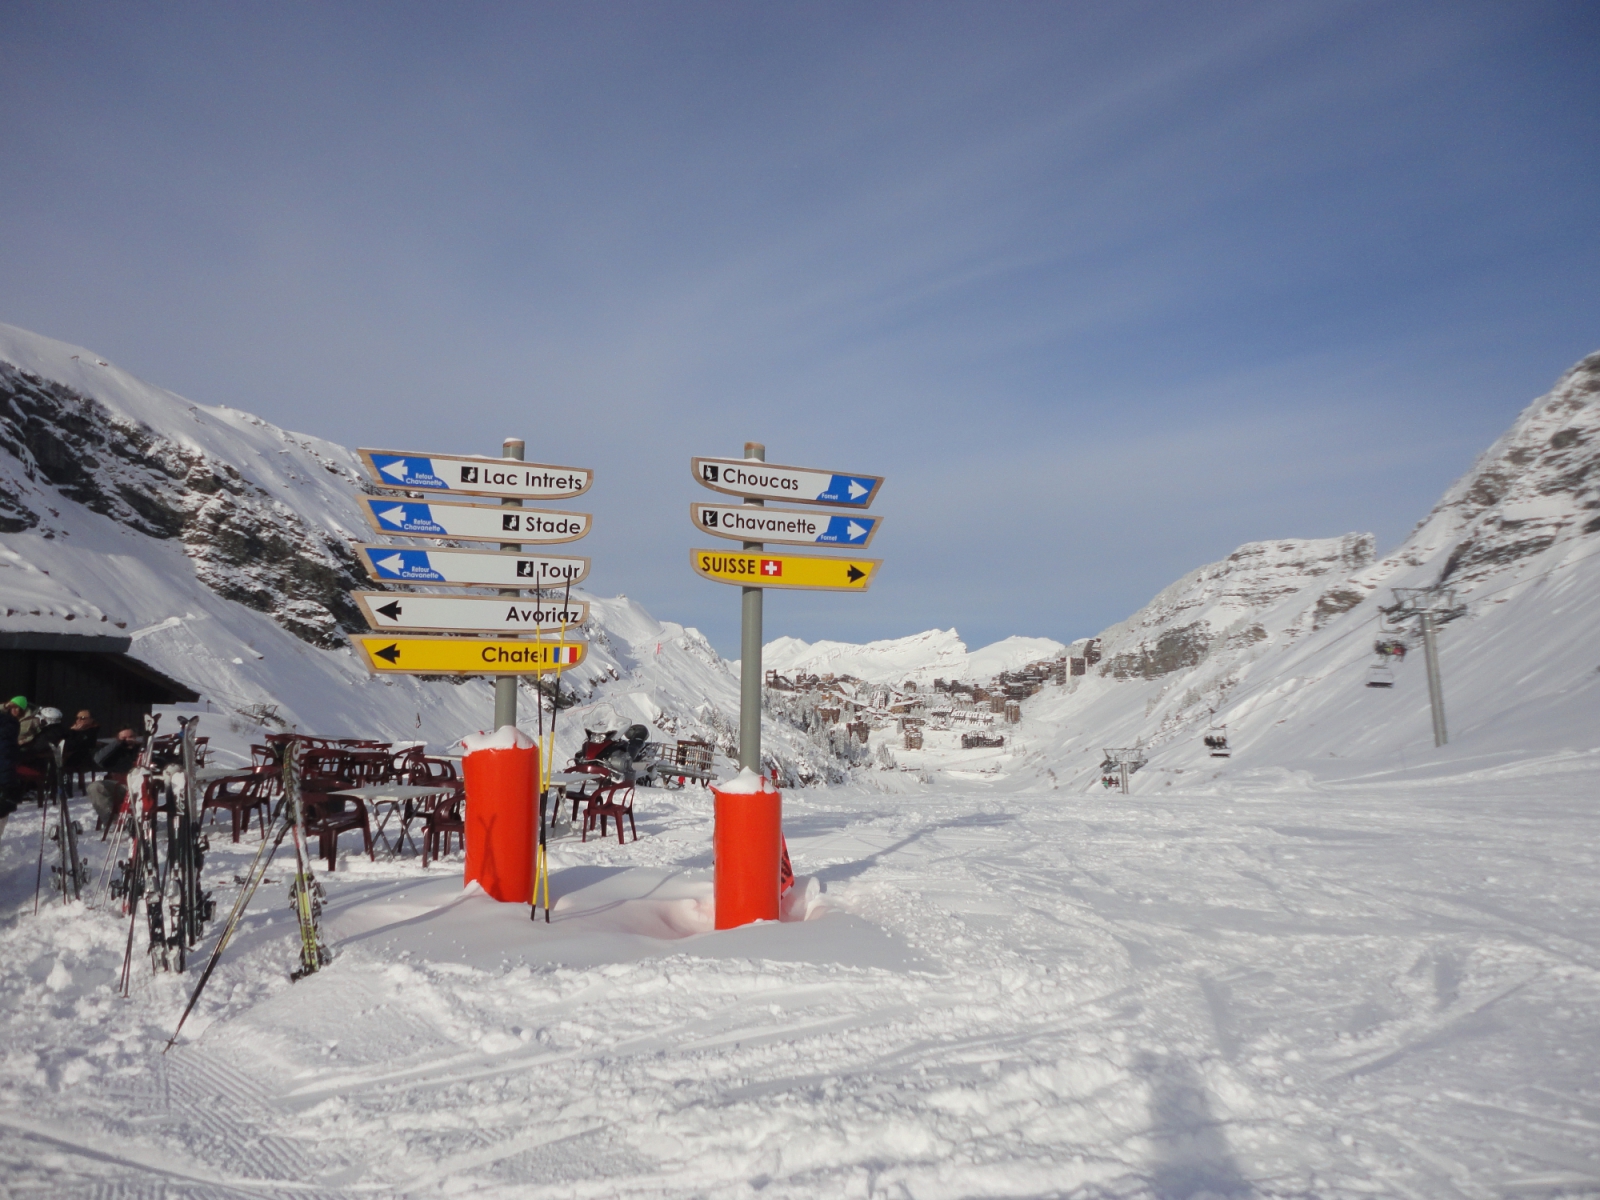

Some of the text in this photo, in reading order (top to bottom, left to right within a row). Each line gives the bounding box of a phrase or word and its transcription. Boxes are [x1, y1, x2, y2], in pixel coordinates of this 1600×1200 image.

[405, 478, 443, 487] Chavanette
[484, 468, 583, 490] Lac Intrets
[723, 468, 799, 491] Choucas
[403, 523, 441, 532] Chavanette
[413, 518, 432, 526] Retour
[525, 516, 581, 534] Stade
[722, 512, 816, 534] Chavanette
[540, 562, 581, 579] Tour
[702, 556, 756, 575] SUISSE
[402, 571, 440, 579] Chavanette
[505, 606, 580, 623] Avoriaz
[481, 647, 548, 664] Chatel
